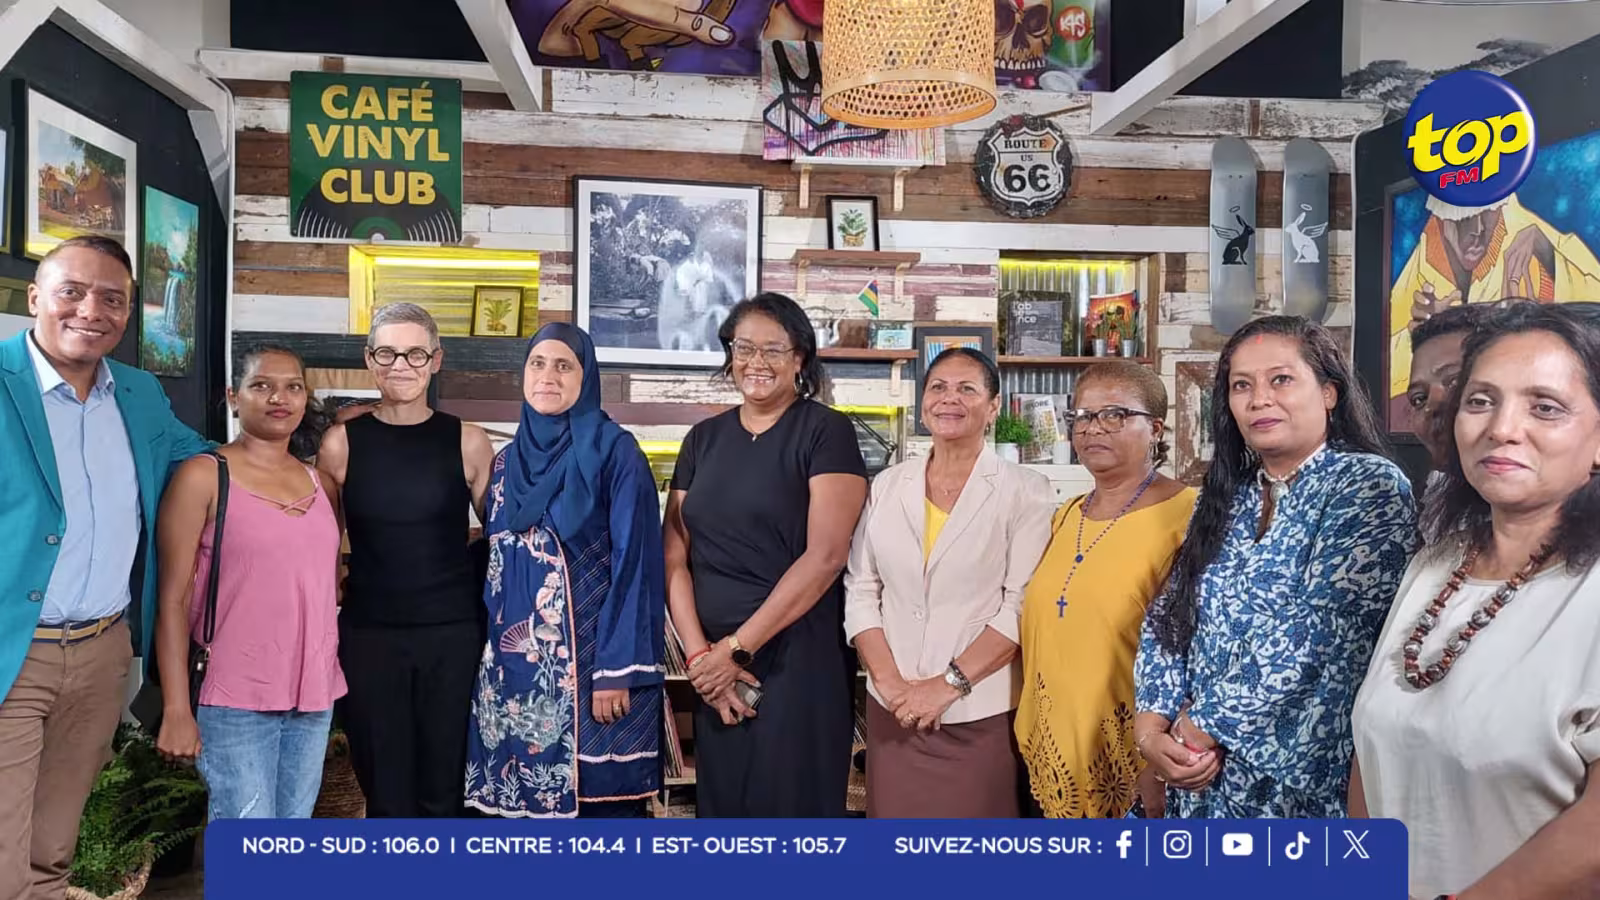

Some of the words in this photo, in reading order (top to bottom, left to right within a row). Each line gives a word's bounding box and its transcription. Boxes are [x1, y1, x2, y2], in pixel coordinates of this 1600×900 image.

[321, 81, 433, 122] CAFÉ
[306, 123, 450, 161] VINYL
[1004, 139, 1047, 149] ROUTE
[320, 168, 436, 205] CLUB
[1003, 164, 1051, 193] 66
